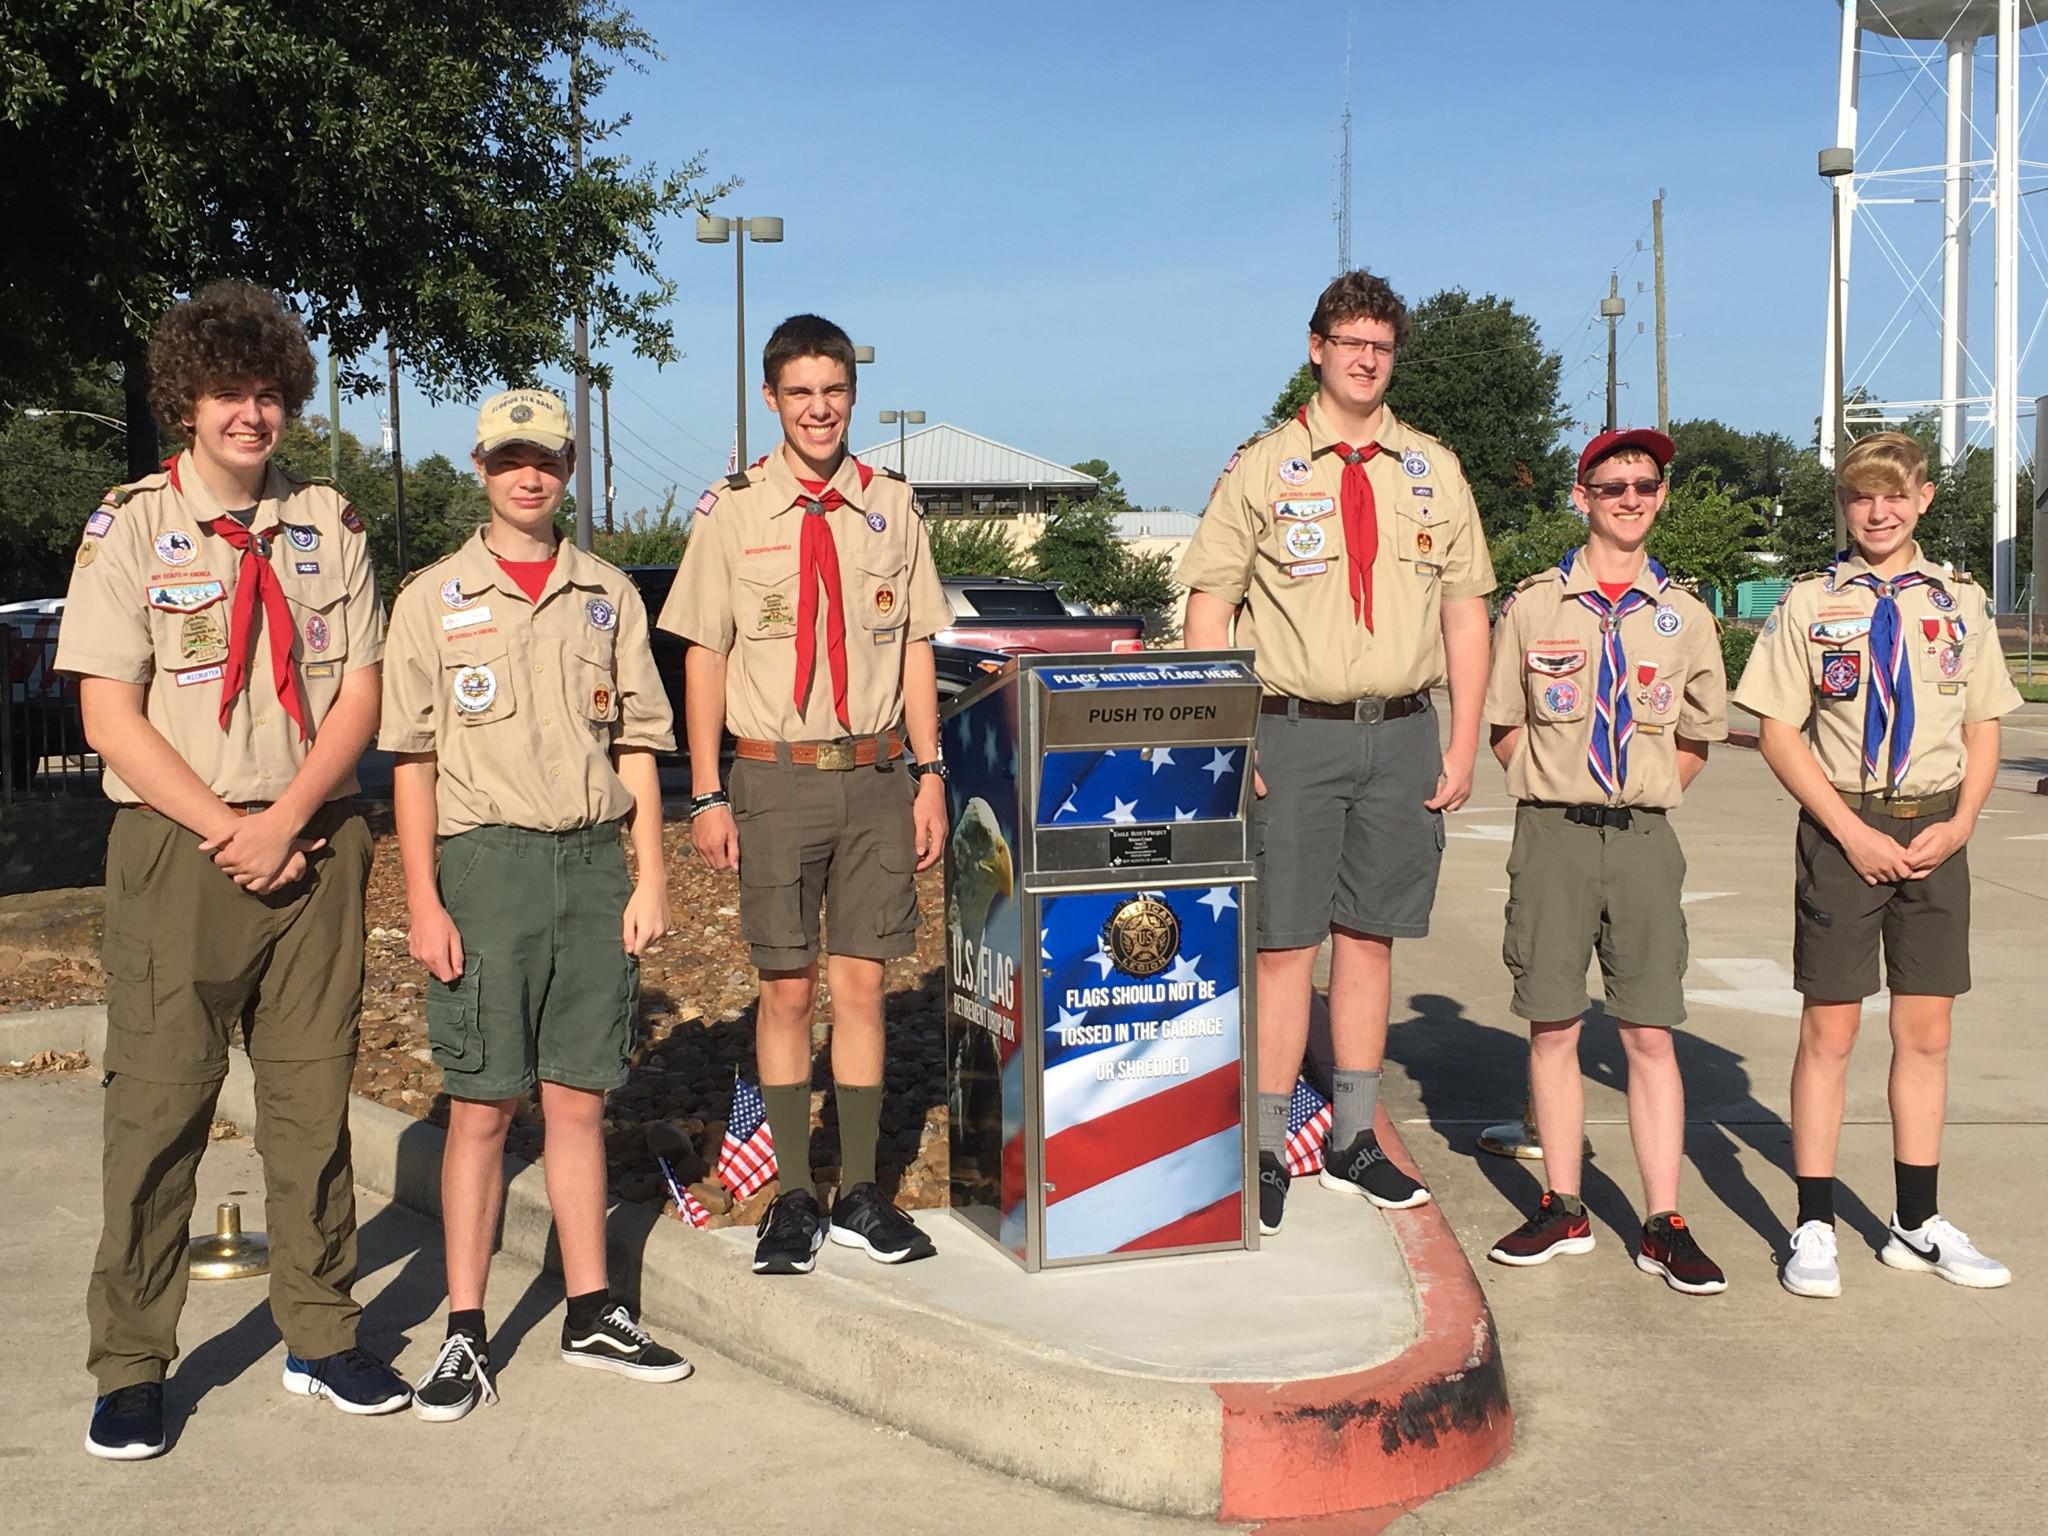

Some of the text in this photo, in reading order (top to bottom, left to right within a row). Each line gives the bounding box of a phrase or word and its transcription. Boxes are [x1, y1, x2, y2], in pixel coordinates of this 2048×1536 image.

[1053, 669, 1243, 685] PLACE RETIRED FLAGS HERE
[1089, 706, 1217, 723] PUSH TO OPEN
[1139, 930, 1155, 946] US
[953, 934, 1014, 1011] U.S. FLAG
[1066, 980, 1216, 1009] FLAGS SHOULD NOT BE
[953, 992, 987, 1029] RETIREMENT
[1002, 1015, 1015, 1043] BOX
[1059, 1016, 1224, 1047] TOSSED IN THE GARBAGE
[1096, 1056, 1190, 1081] OR SHREDDED
